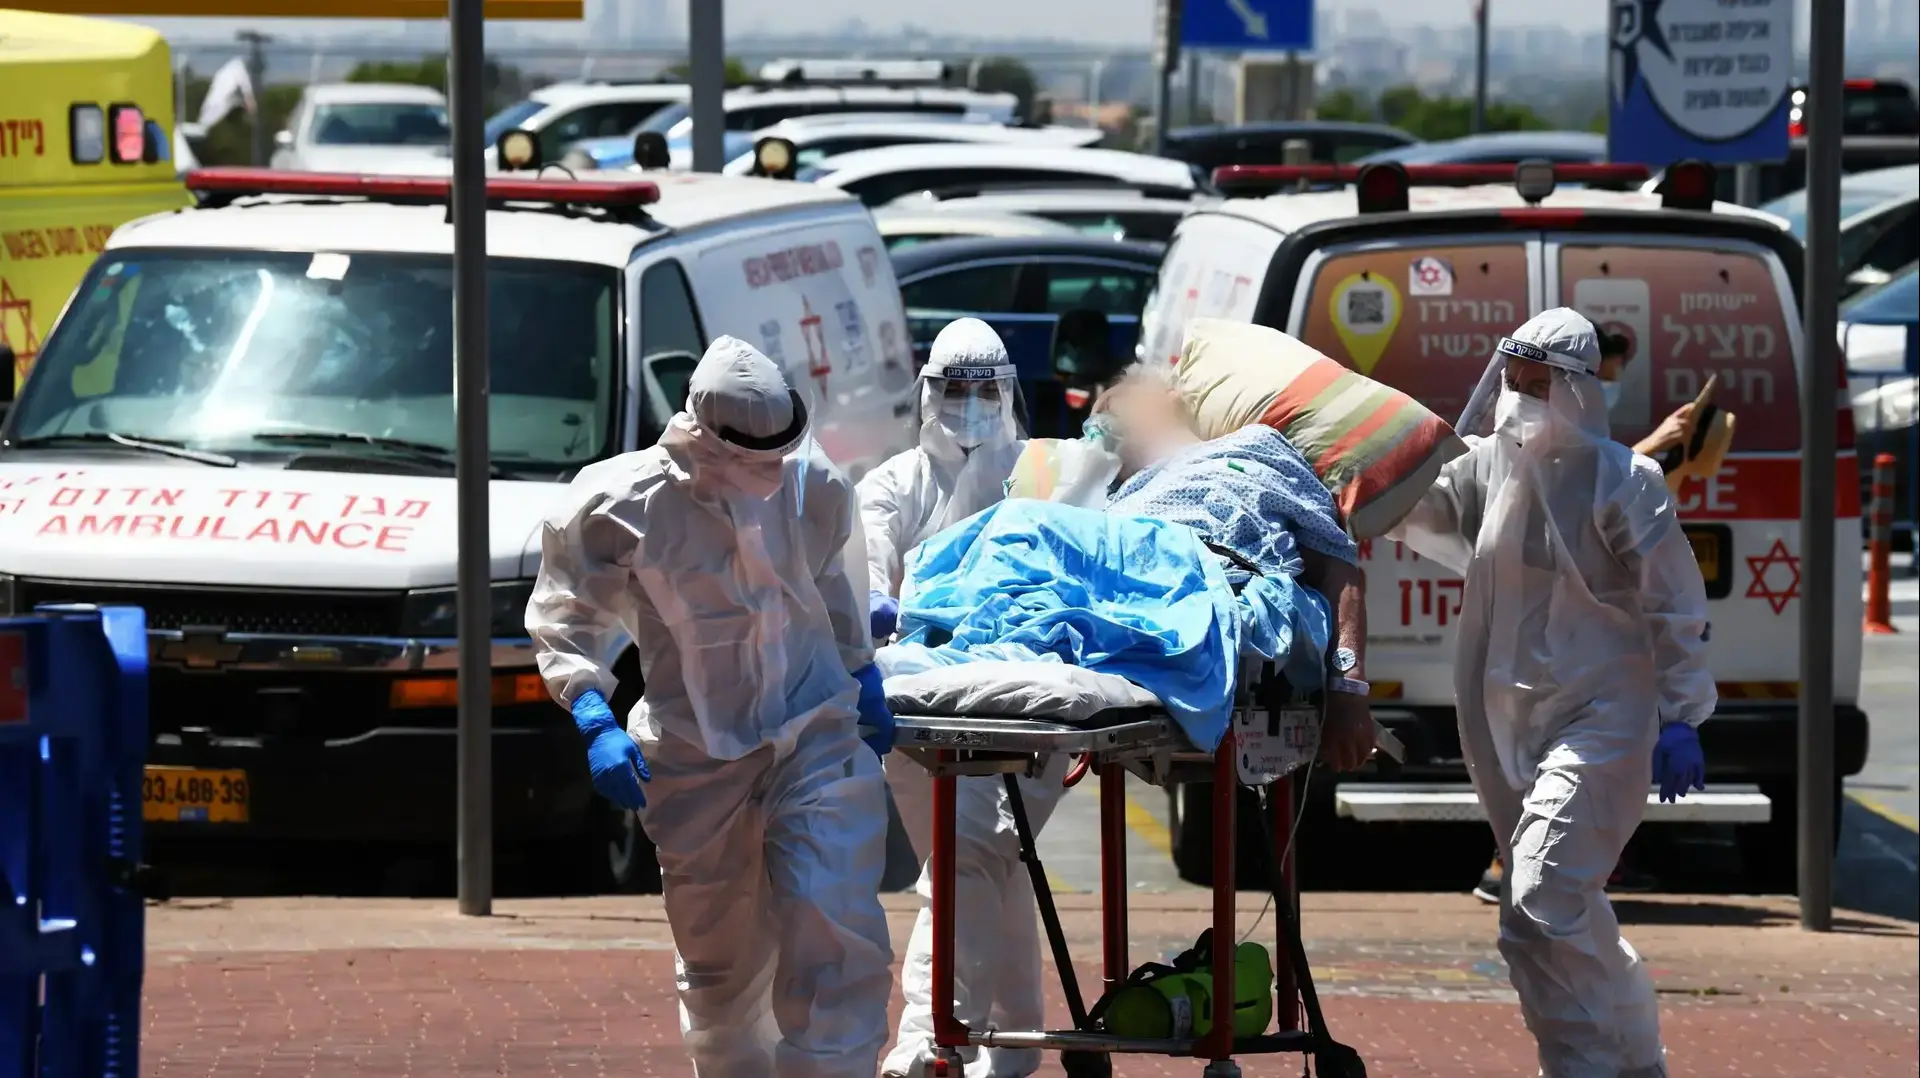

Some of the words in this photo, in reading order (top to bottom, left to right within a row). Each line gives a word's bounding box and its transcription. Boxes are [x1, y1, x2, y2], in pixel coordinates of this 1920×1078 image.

[0, 119, 44, 157] נייד
[1420, 300, 1514, 323] הורידו
[1680, 292, 1758, 315] יישומון
[1503, 340, 1516, 351] מגן
[1662, 314, 1776, 360] מציל
[1516, 344, 1544, 359] משקף
[947, 368, 961, 377] מגן
[963, 368, 992, 379] משקף
[48, 487, 186, 507] אדום
[218, 489, 312, 510] דוד
[340, 494, 432, 519] מגן
[35, 514, 415, 552] AMBULANCE
[1397, 578, 1466, 627] קון
